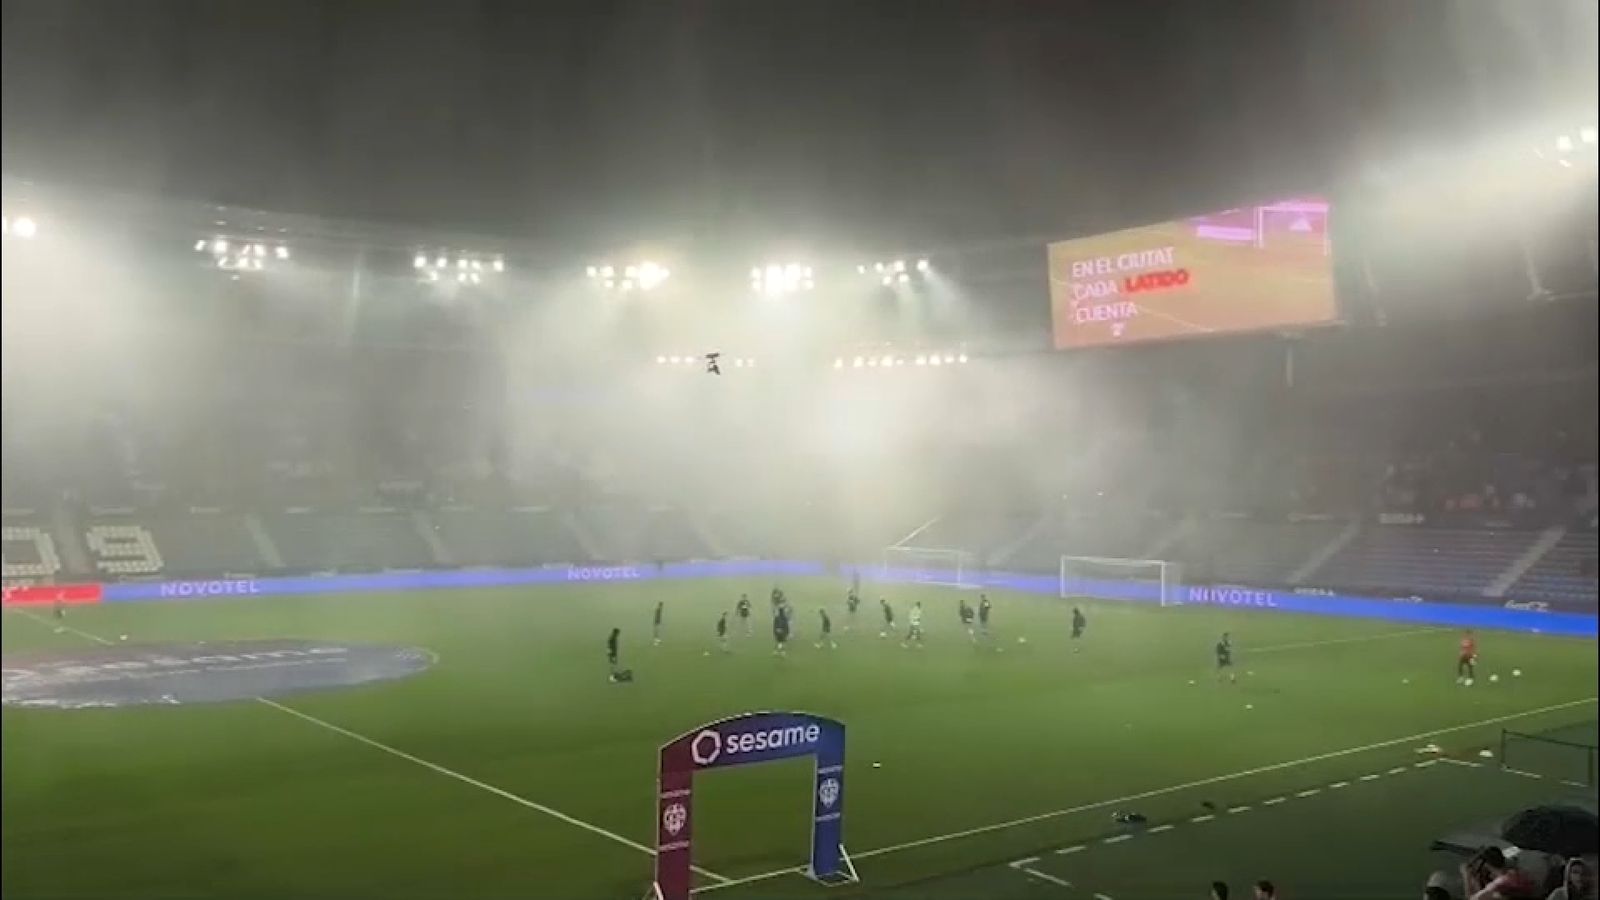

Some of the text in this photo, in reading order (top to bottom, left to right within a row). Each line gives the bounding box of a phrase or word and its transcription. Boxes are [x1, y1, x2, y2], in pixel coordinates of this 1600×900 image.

[1072, 260, 1094, 278] EN
[1117, 247, 1174, 269] CIUTAT
[1077, 302, 1138, 322] CUENTA
[161, 580, 260, 597] NOVOTEL
[726, 724, 821, 754] sesame
